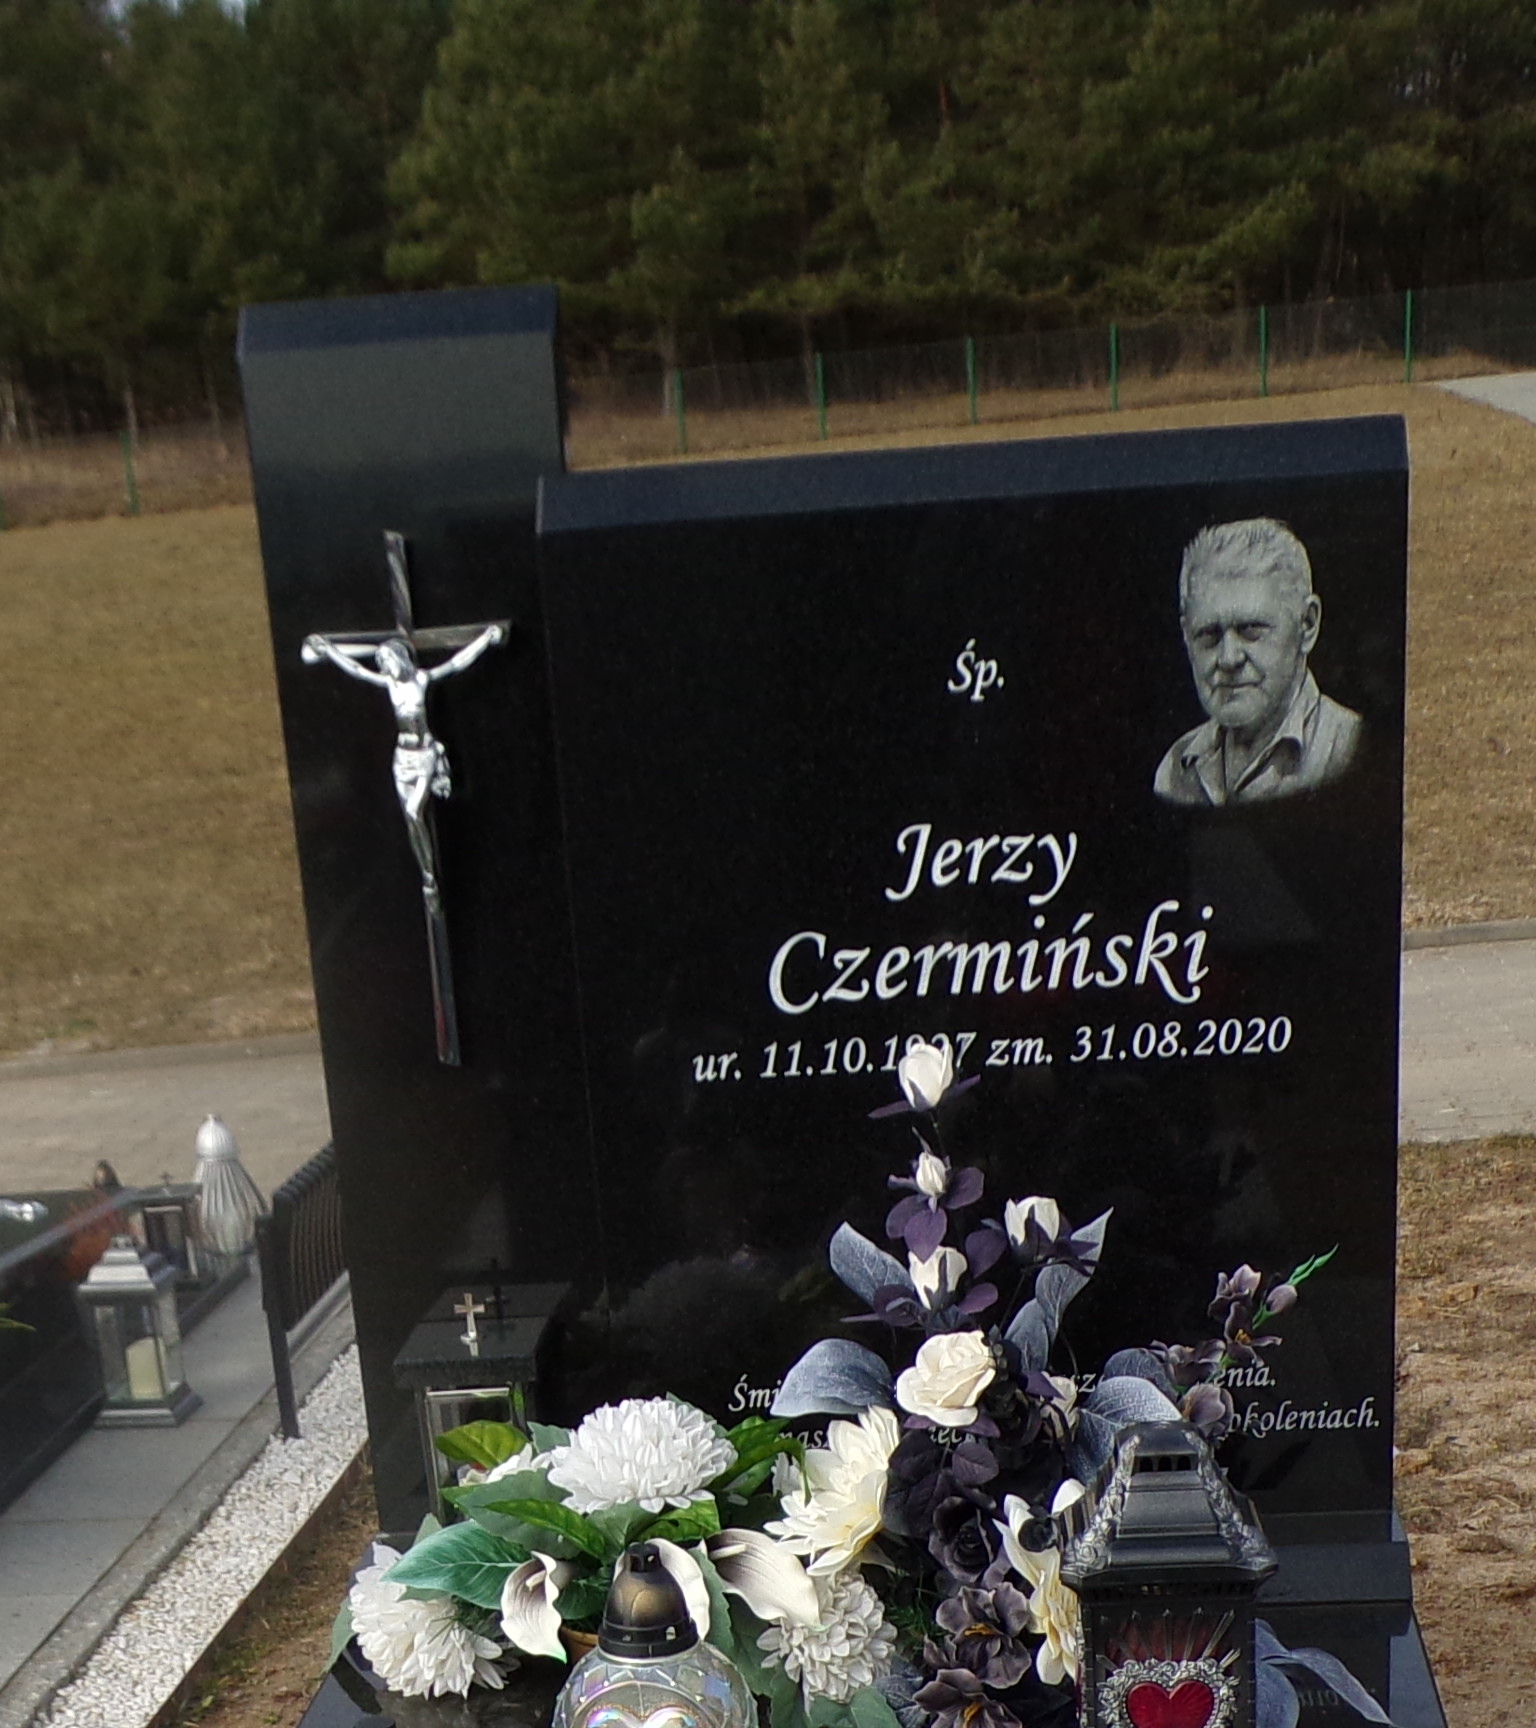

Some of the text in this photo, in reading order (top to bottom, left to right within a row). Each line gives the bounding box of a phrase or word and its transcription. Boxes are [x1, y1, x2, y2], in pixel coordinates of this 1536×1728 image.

[947, 639, 1005, 700] Śp.
[885, 823, 1078, 906] Jerzy
[768, 900, 1214, 1015] Czermiński
[693, 1050, 741, 1083] ur.
[985, 1036, 1053, 1069] zm.
[1070, 1015, 1292, 1062] 31.08.2020
